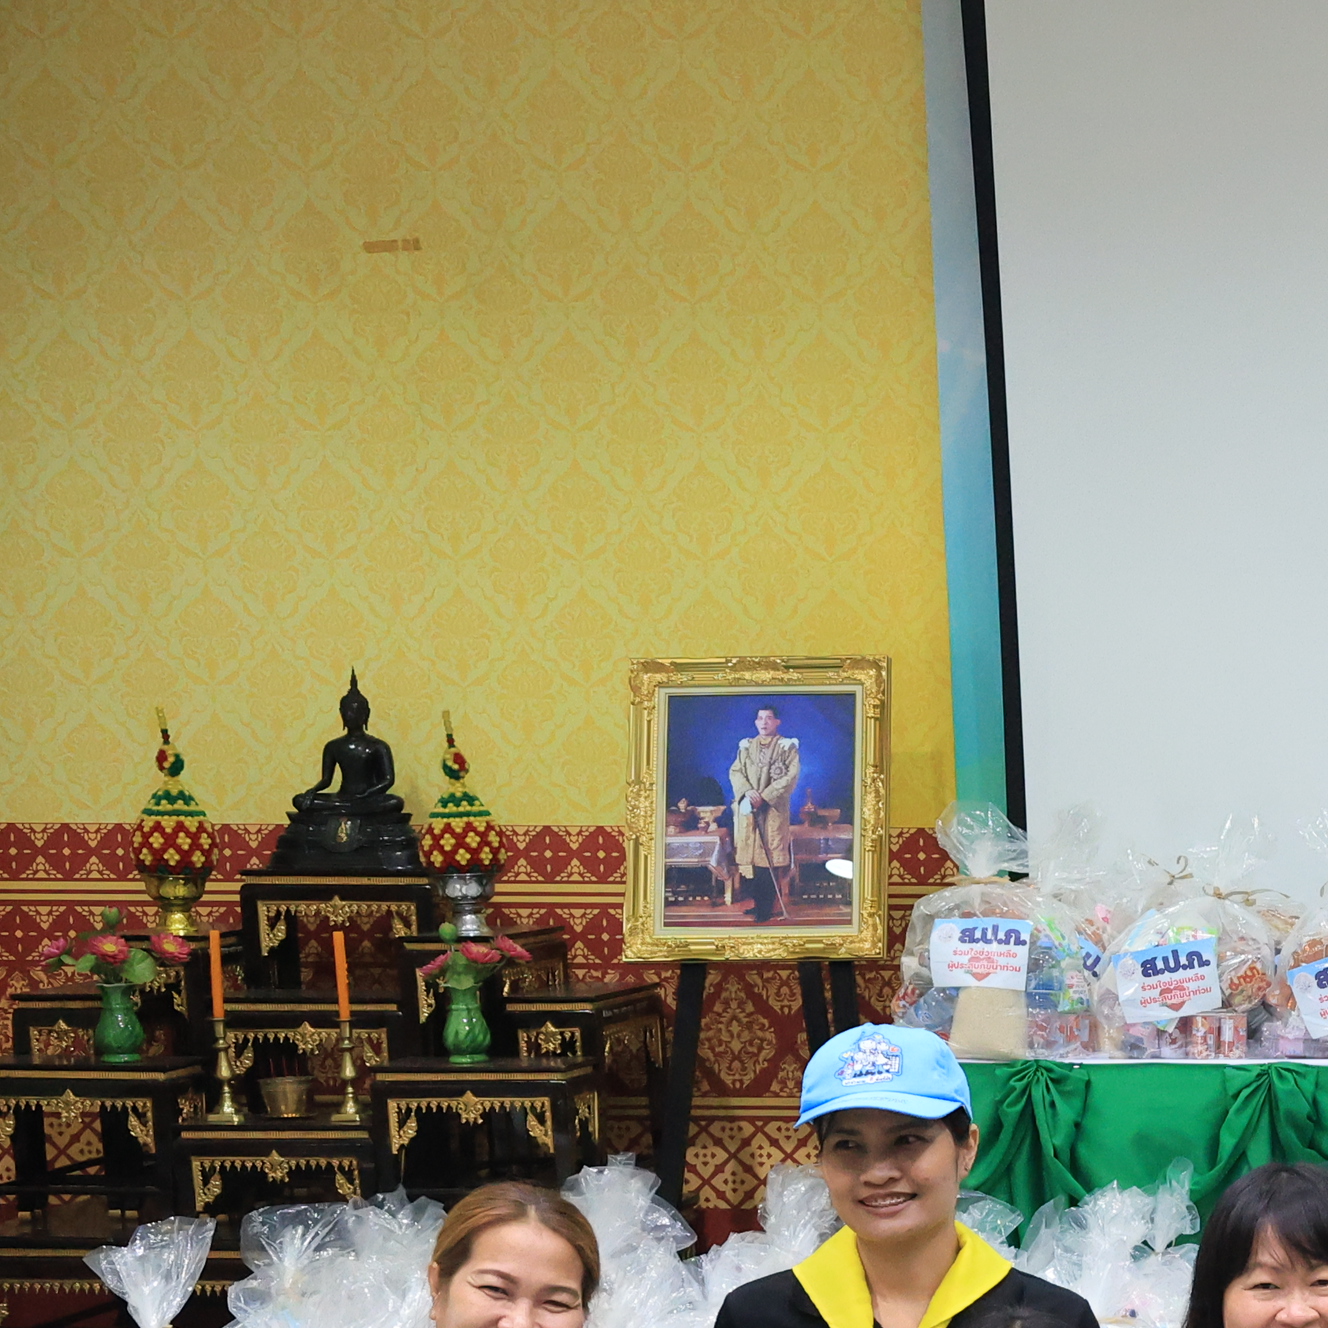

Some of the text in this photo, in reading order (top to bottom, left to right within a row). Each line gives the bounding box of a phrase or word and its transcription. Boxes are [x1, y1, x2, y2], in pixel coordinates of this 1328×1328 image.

[959, 924, 1027, 946] ส.ป.ก.
[1141, 949, 1211, 978] ส.ป.ก.
[1141, 973, 1206, 992] ร่วมใจช่วยเหลือ
[1140, 985, 1212, 1008] ผู้ประสบภัยน้ำท่วม
